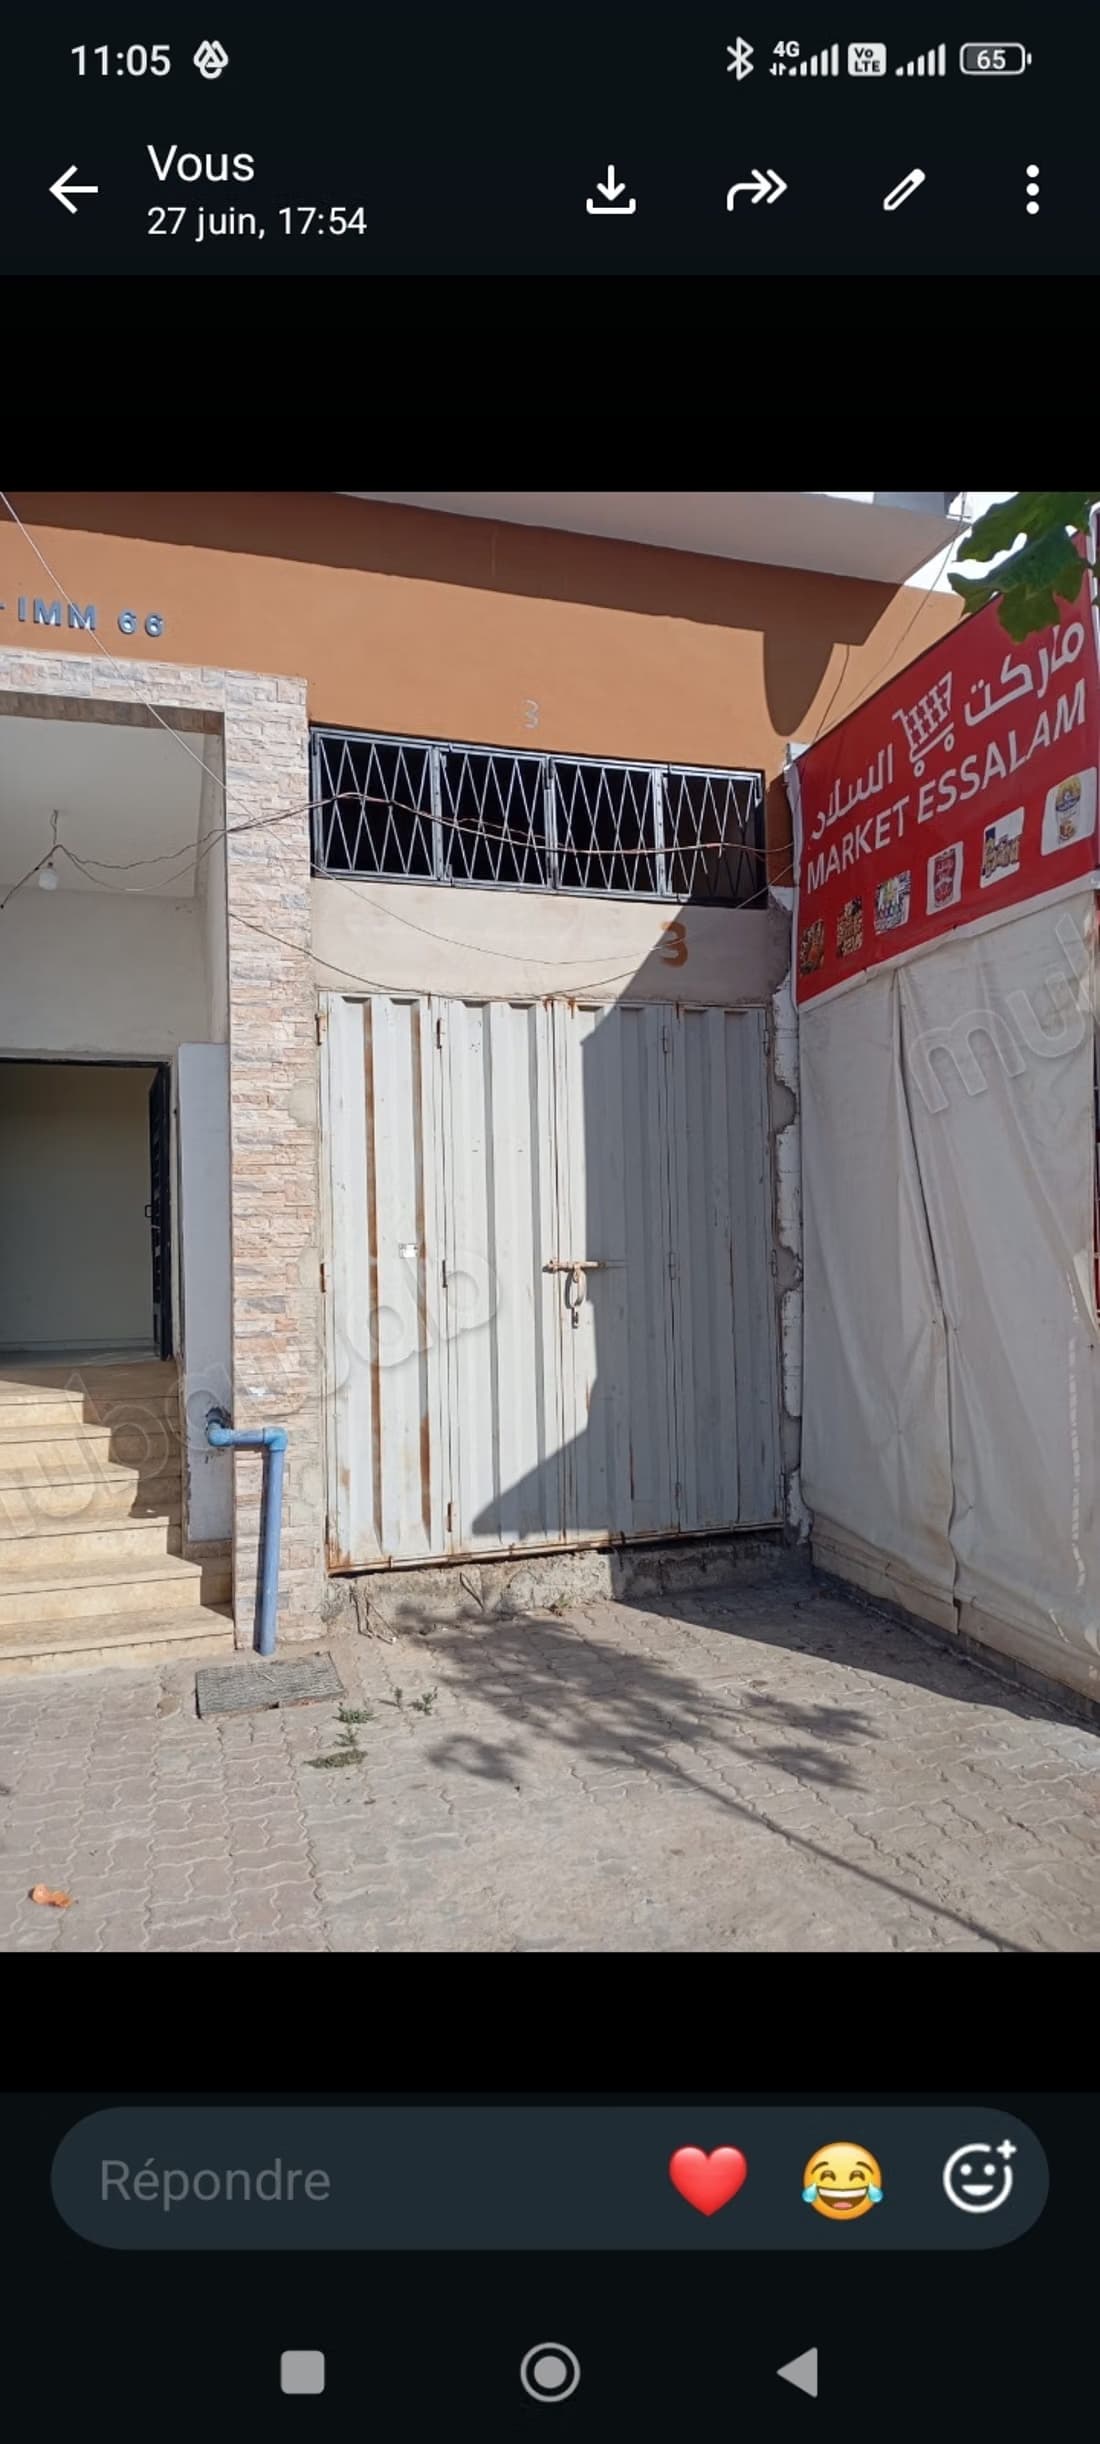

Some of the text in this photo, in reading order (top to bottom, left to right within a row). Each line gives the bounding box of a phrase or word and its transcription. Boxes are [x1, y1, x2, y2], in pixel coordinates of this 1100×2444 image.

[71, 44, 171, 77] 11:05
[772, 40, 800, 58] 4G
[854, 47, 874, 59] Vo
[854, 60, 881, 73] LTE
[976, 49, 1006, 71] 65
[147, 144, 255, 182] Vous
[147, 206, 368, 242] 27 juin, 17:54
[18, 595, 164, 637] IMM 66
[964, 622, 1085, 726] ماركت
[522, 698, 540, 729] 3
[807, 795, 910, 895] MARKET
[917, 678, 1086, 825] ESSALAM
[660, 920, 689, 968] 3
[101, 2156, 332, 2213] Répondre
